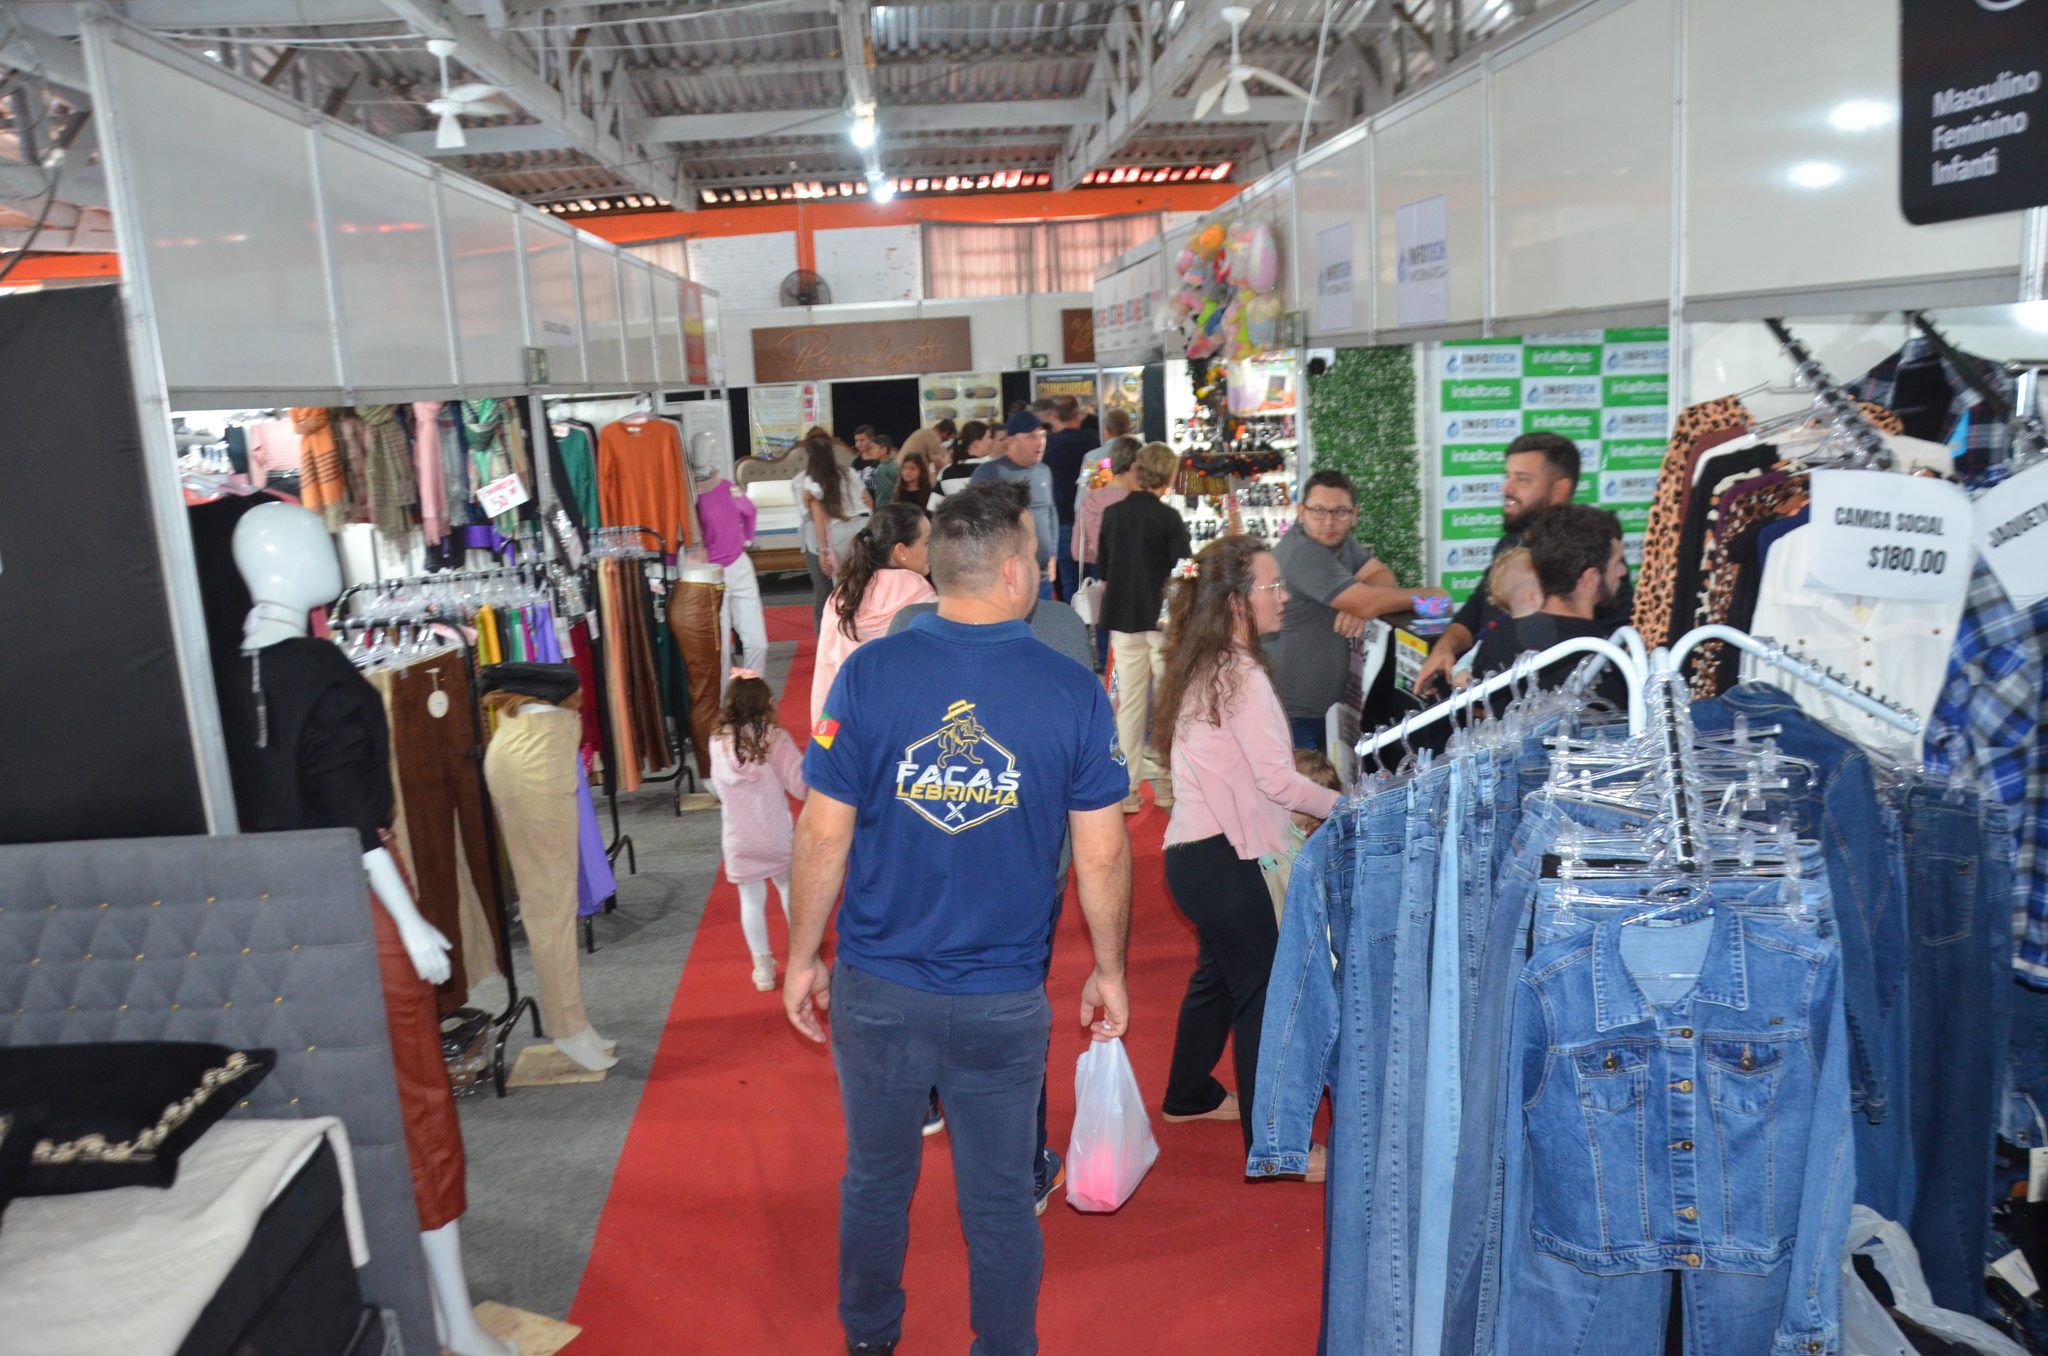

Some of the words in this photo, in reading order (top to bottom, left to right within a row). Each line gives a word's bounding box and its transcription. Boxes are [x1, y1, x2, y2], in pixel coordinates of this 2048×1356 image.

[1931, 70, 2042, 118] Masculino
[1931, 110, 2030, 152] Feminino
[1463, 352, 1516, 364] INFOTECH
[1452, 384, 1512, 399] intelbras
[1463, 417, 1516, 429] INFOTECH
[1834, 506, 1892, 530] CAMISA
[1896, 512, 1945, 536] SOCIAL
[1867, 545, 1947, 576] $180,00
[896, 761, 1022, 791] FACAS
[896, 783, 1019, 806] LEBRINHA
